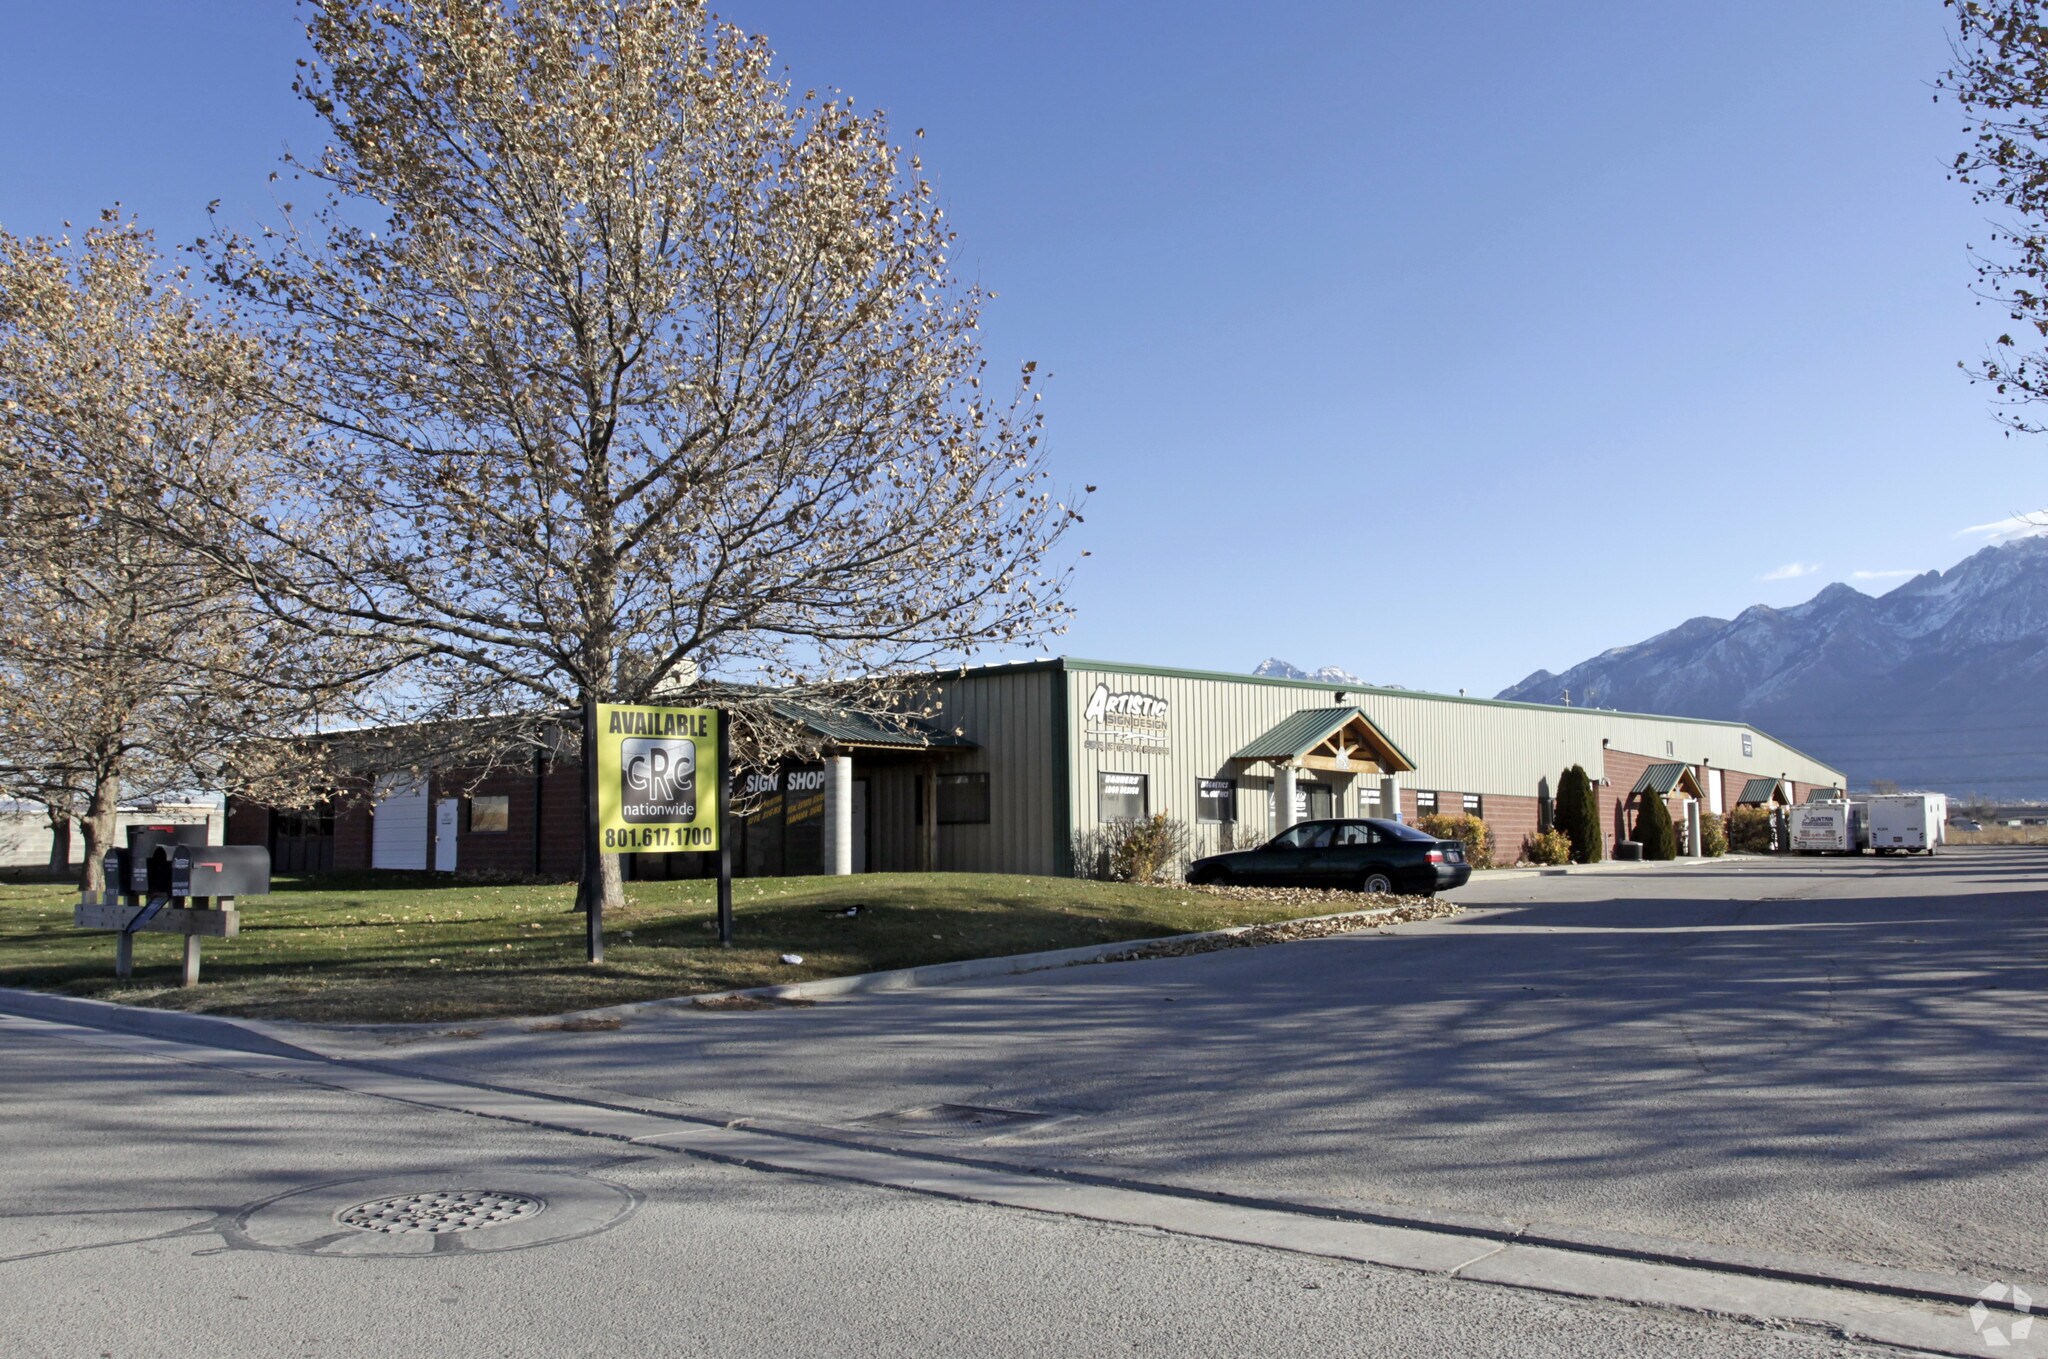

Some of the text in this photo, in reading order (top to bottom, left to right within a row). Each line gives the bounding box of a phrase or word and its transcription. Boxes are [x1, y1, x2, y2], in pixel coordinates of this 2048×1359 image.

[1084, 683, 1168, 724] ARTISTIC
[609, 711, 708, 737] AVAILABLE
[1107, 714, 1168, 731] SIGN DESIGN
[627, 747, 693, 801] CRC
[746, 774, 779, 793] SIGN
[787, 771, 824, 791] SHOP
[1104, 775, 1139, 785] BANNERS
[624, 803, 694, 816] nationwide
[605, 827, 712, 848] 801.617.1700
